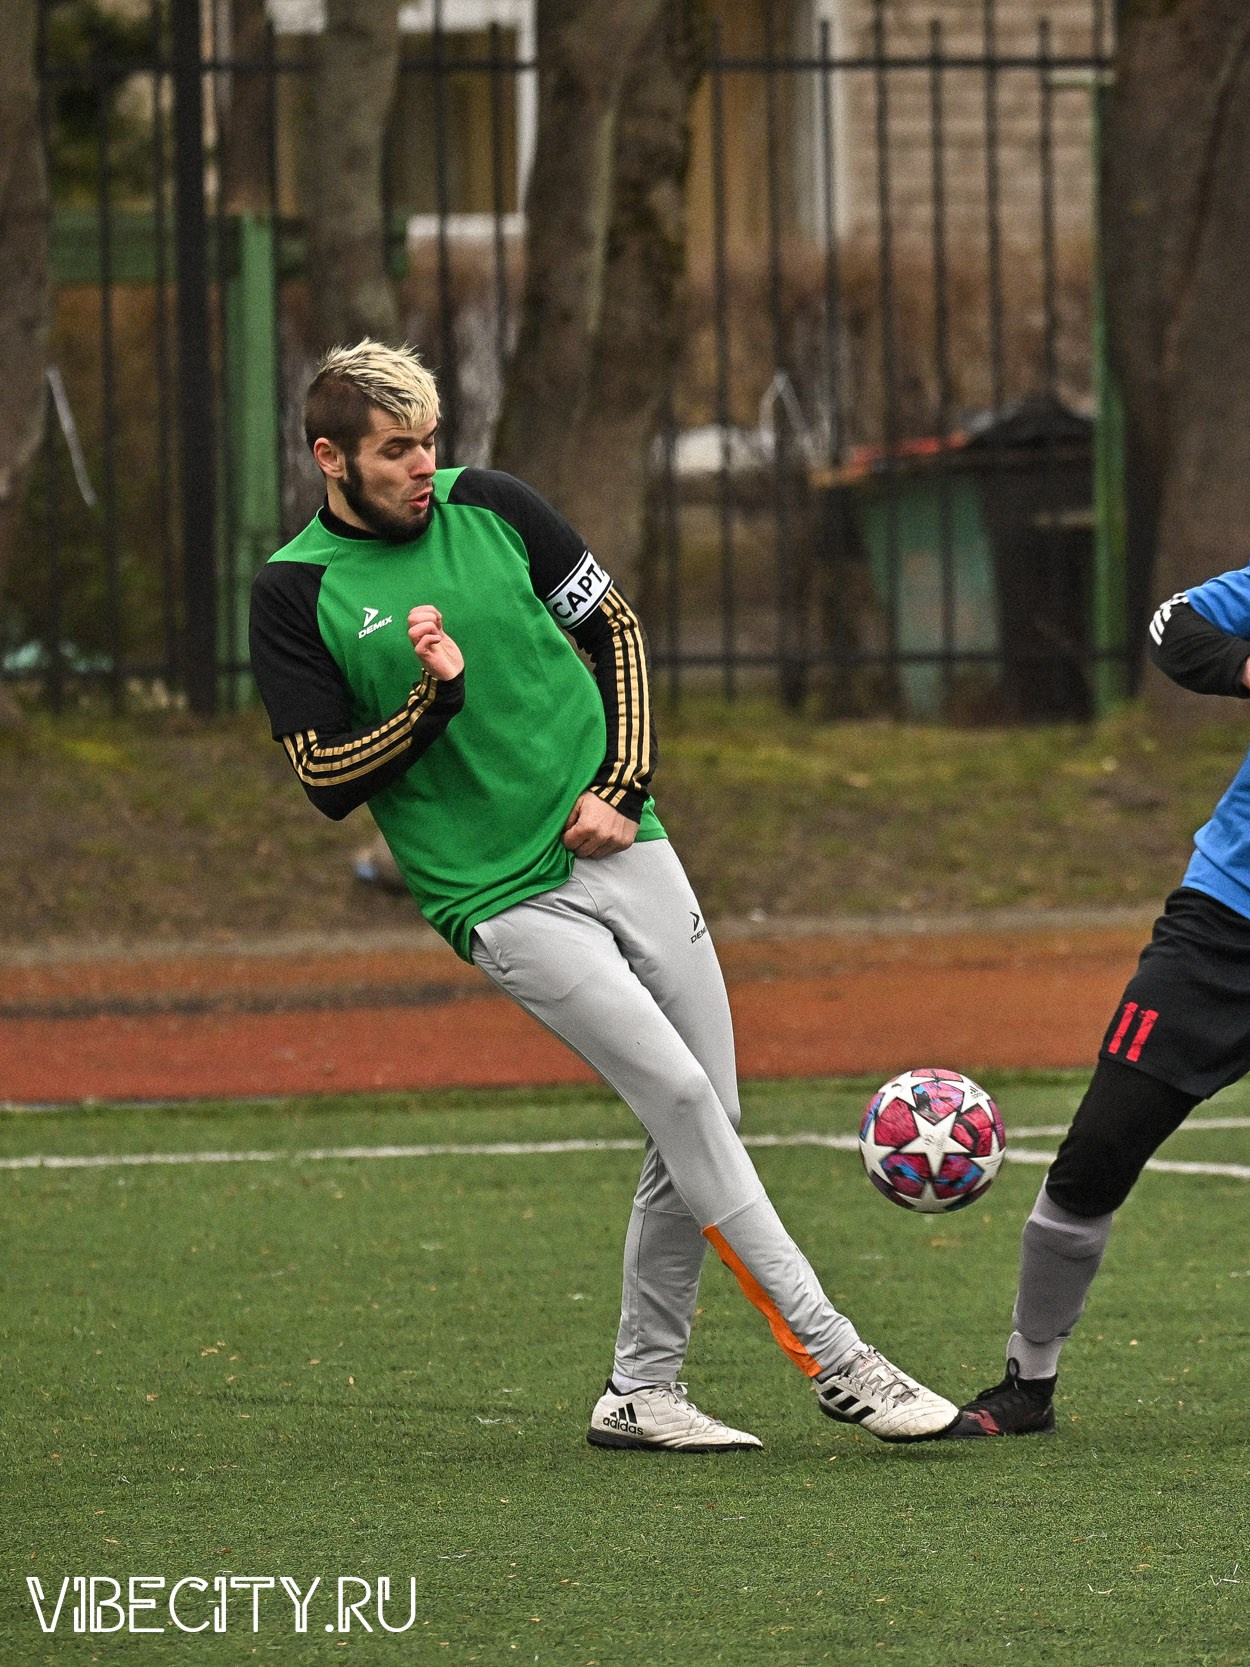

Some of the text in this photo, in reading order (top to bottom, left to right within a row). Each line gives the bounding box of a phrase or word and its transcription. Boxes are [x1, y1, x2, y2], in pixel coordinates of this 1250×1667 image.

[553, 563, 605, 619] CAPT
[1107, 1001, 1159, 1062] 11
[602, 1416, 644, 1436] adidas
